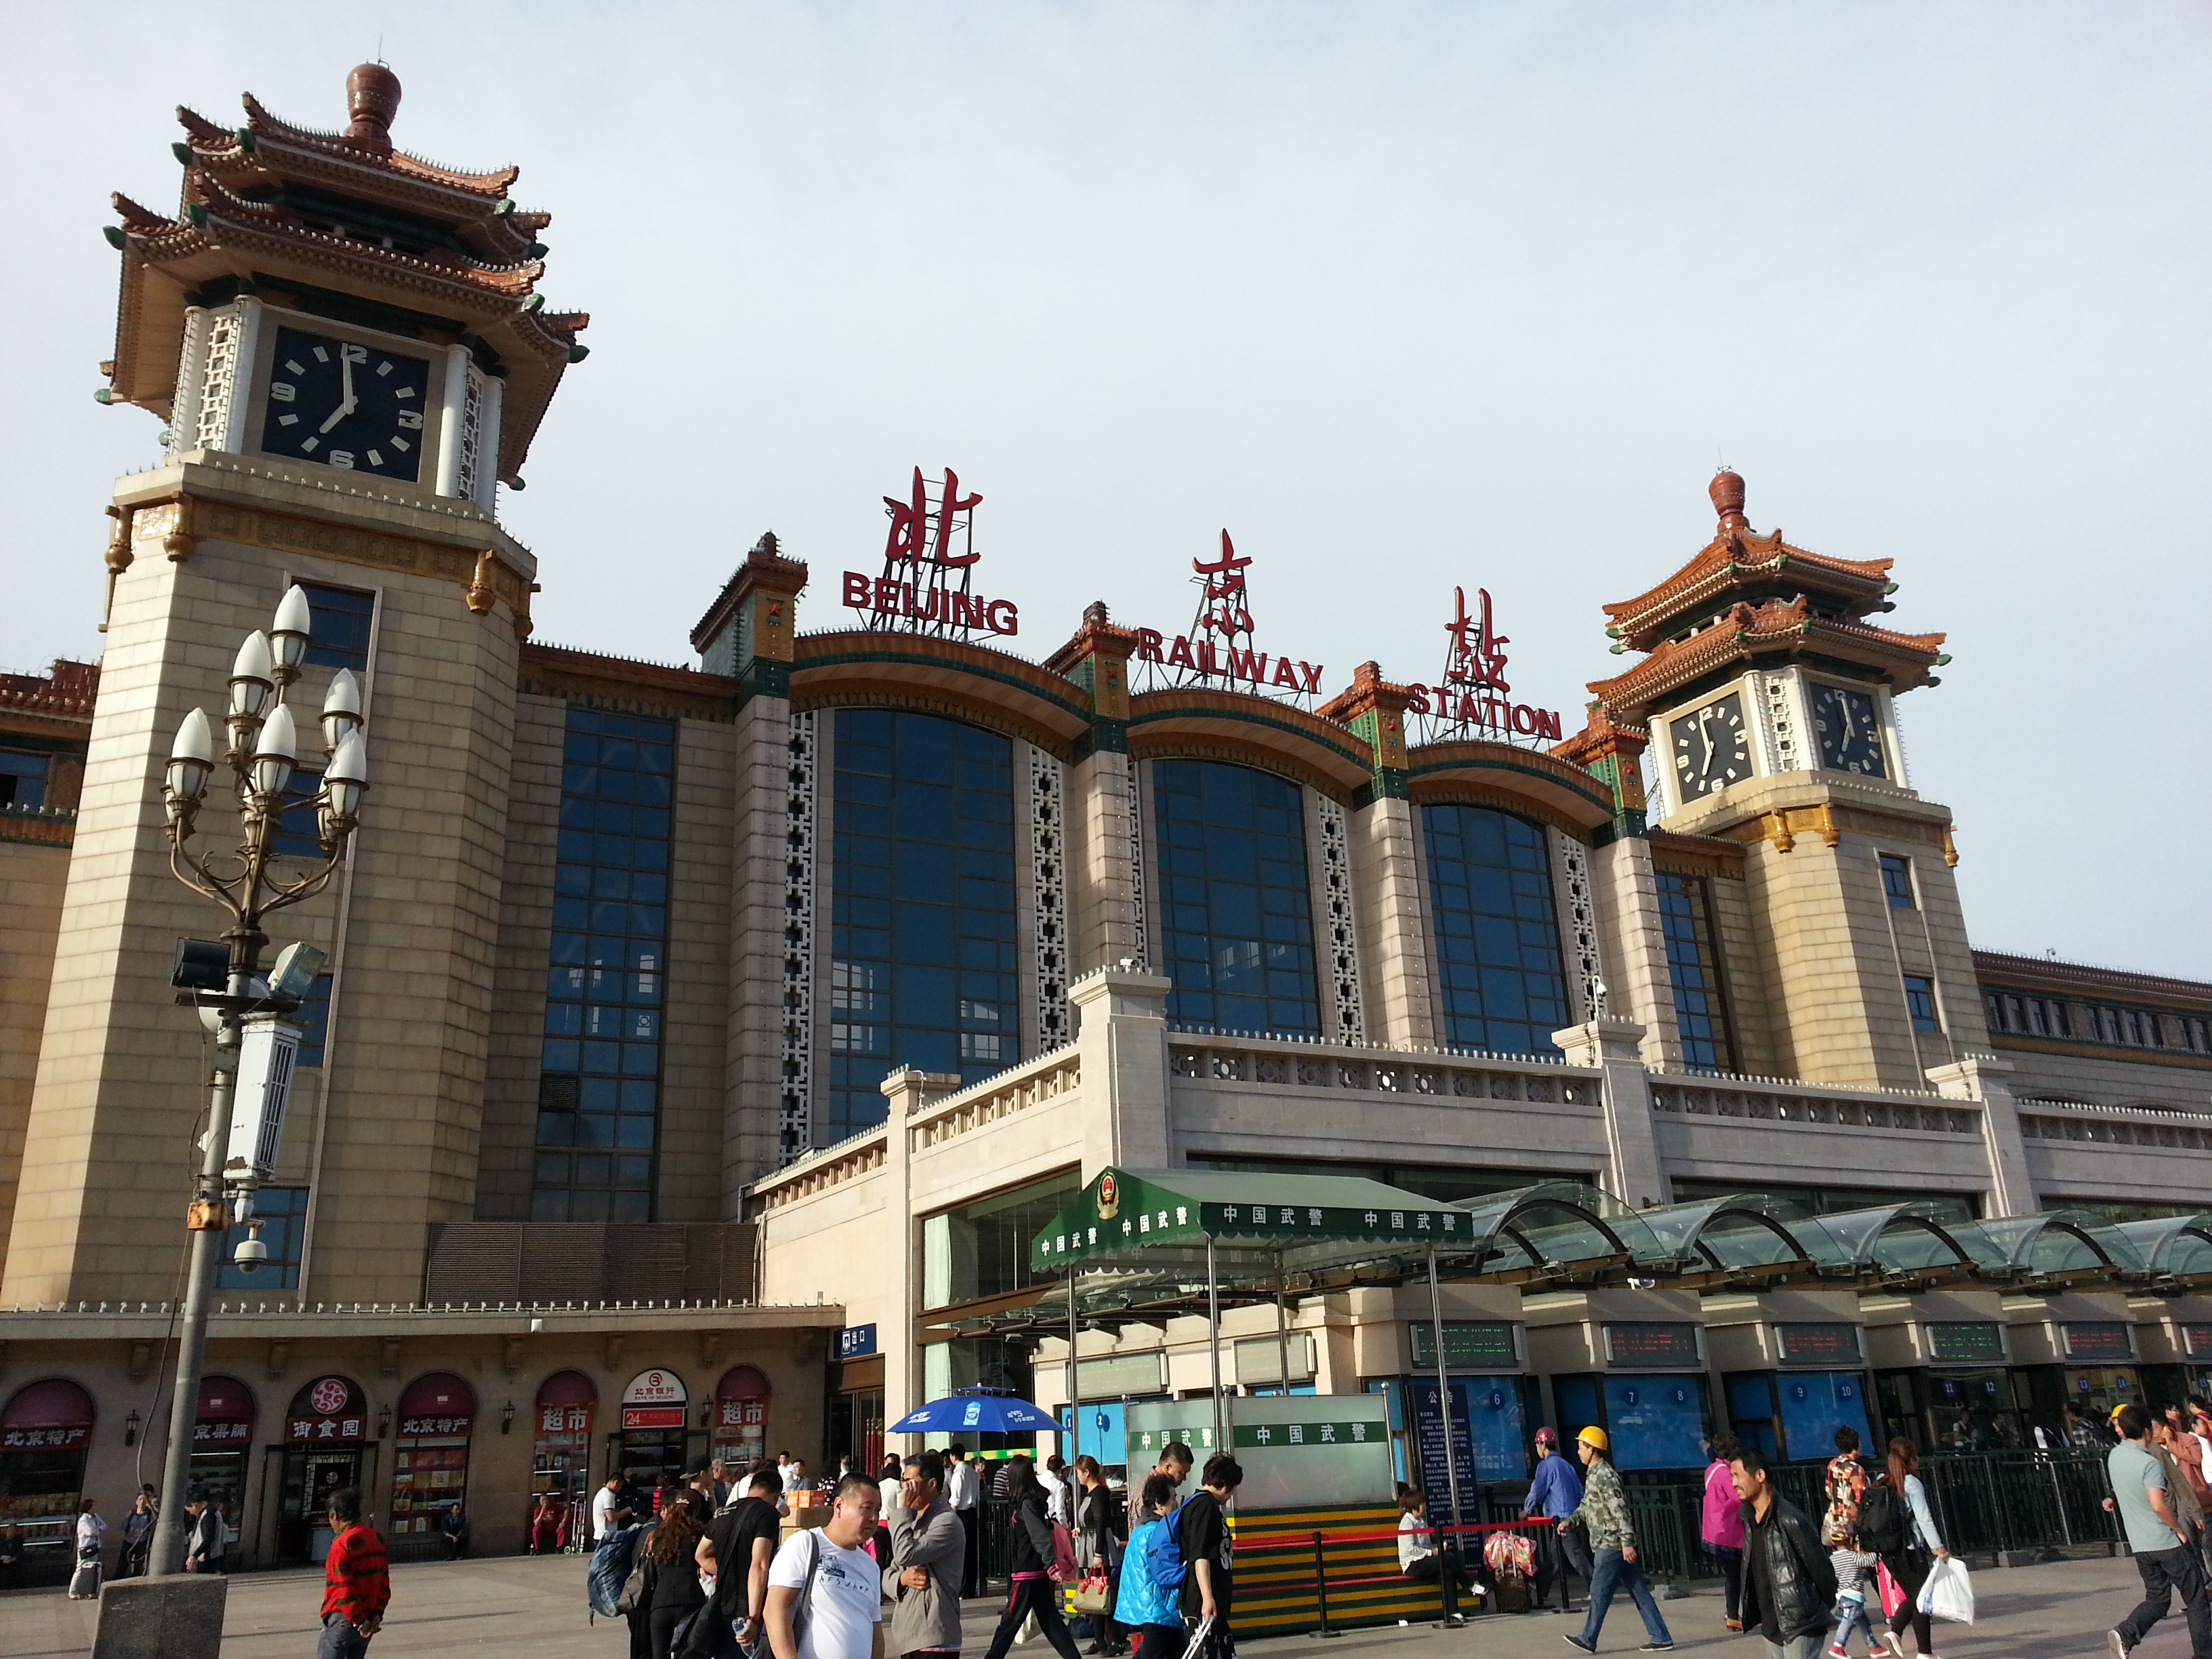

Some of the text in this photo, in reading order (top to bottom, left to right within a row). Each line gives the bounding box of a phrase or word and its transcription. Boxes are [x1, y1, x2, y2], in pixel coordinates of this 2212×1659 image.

[340, 342, 367, 364] 12
[271, 382, 295, 401] 9
[398, 409, 423, 429] 3
[329, 450, 354, 469] 6
[882, 465, 1511, 693] 北 京 站
[842, 571, 1562, 741] BEIJING RAILWAY STATION
[1734, 729, 1747, 745] 3
[1677, 754, 1689, 769] 9
[1849, 761, 1860, 773] 6
[1711, 778, 1724, 792] 6
[1122, 1206, 1187, 1237] 中国武警
[1223, 1205, 1323, 1227] 中国武警
[1364, 1210, 1456, 1232] 中国武警
[1042, 1227, 1097, 1256] 中国武警
[852, 1330, 865, 1345] 出口
[634, 1387, 675, 1395] 北京银行
[1842, 1386, 1851, 1397] 10
[1944, 1383, 1954, 1393] 11
[1985, 1381, 1994, 1392] 12
[2079, 1379, 2088, 1389] 13
[2118, 1378, 2127, 1389] 14
[1494, 1393, 1500, 1406] 6
[1629, 1392, 1634, 1403] 7
[1677, 1390, 1683, 1401] 8
[1797, 1387, 1803, 1397] 9
[542, 1406, 588, 1432] 超市
[626, 1412, 640, 1425] 24
[722, 1401, 764, 1425] 超市
[1098, 1415, 1103, 1426] 2
[293, 1419, 360, 1439] 御食园
[403, 1417, 469, 1435] 北京特产
[1067, 1418, 1071, 1428] 1
[4, 1428, 86, 1447] 北京特产
[1141, 1427, 1212, 1450] 中国武警
[1257, 1422, 1366, 1445] 中国武警
